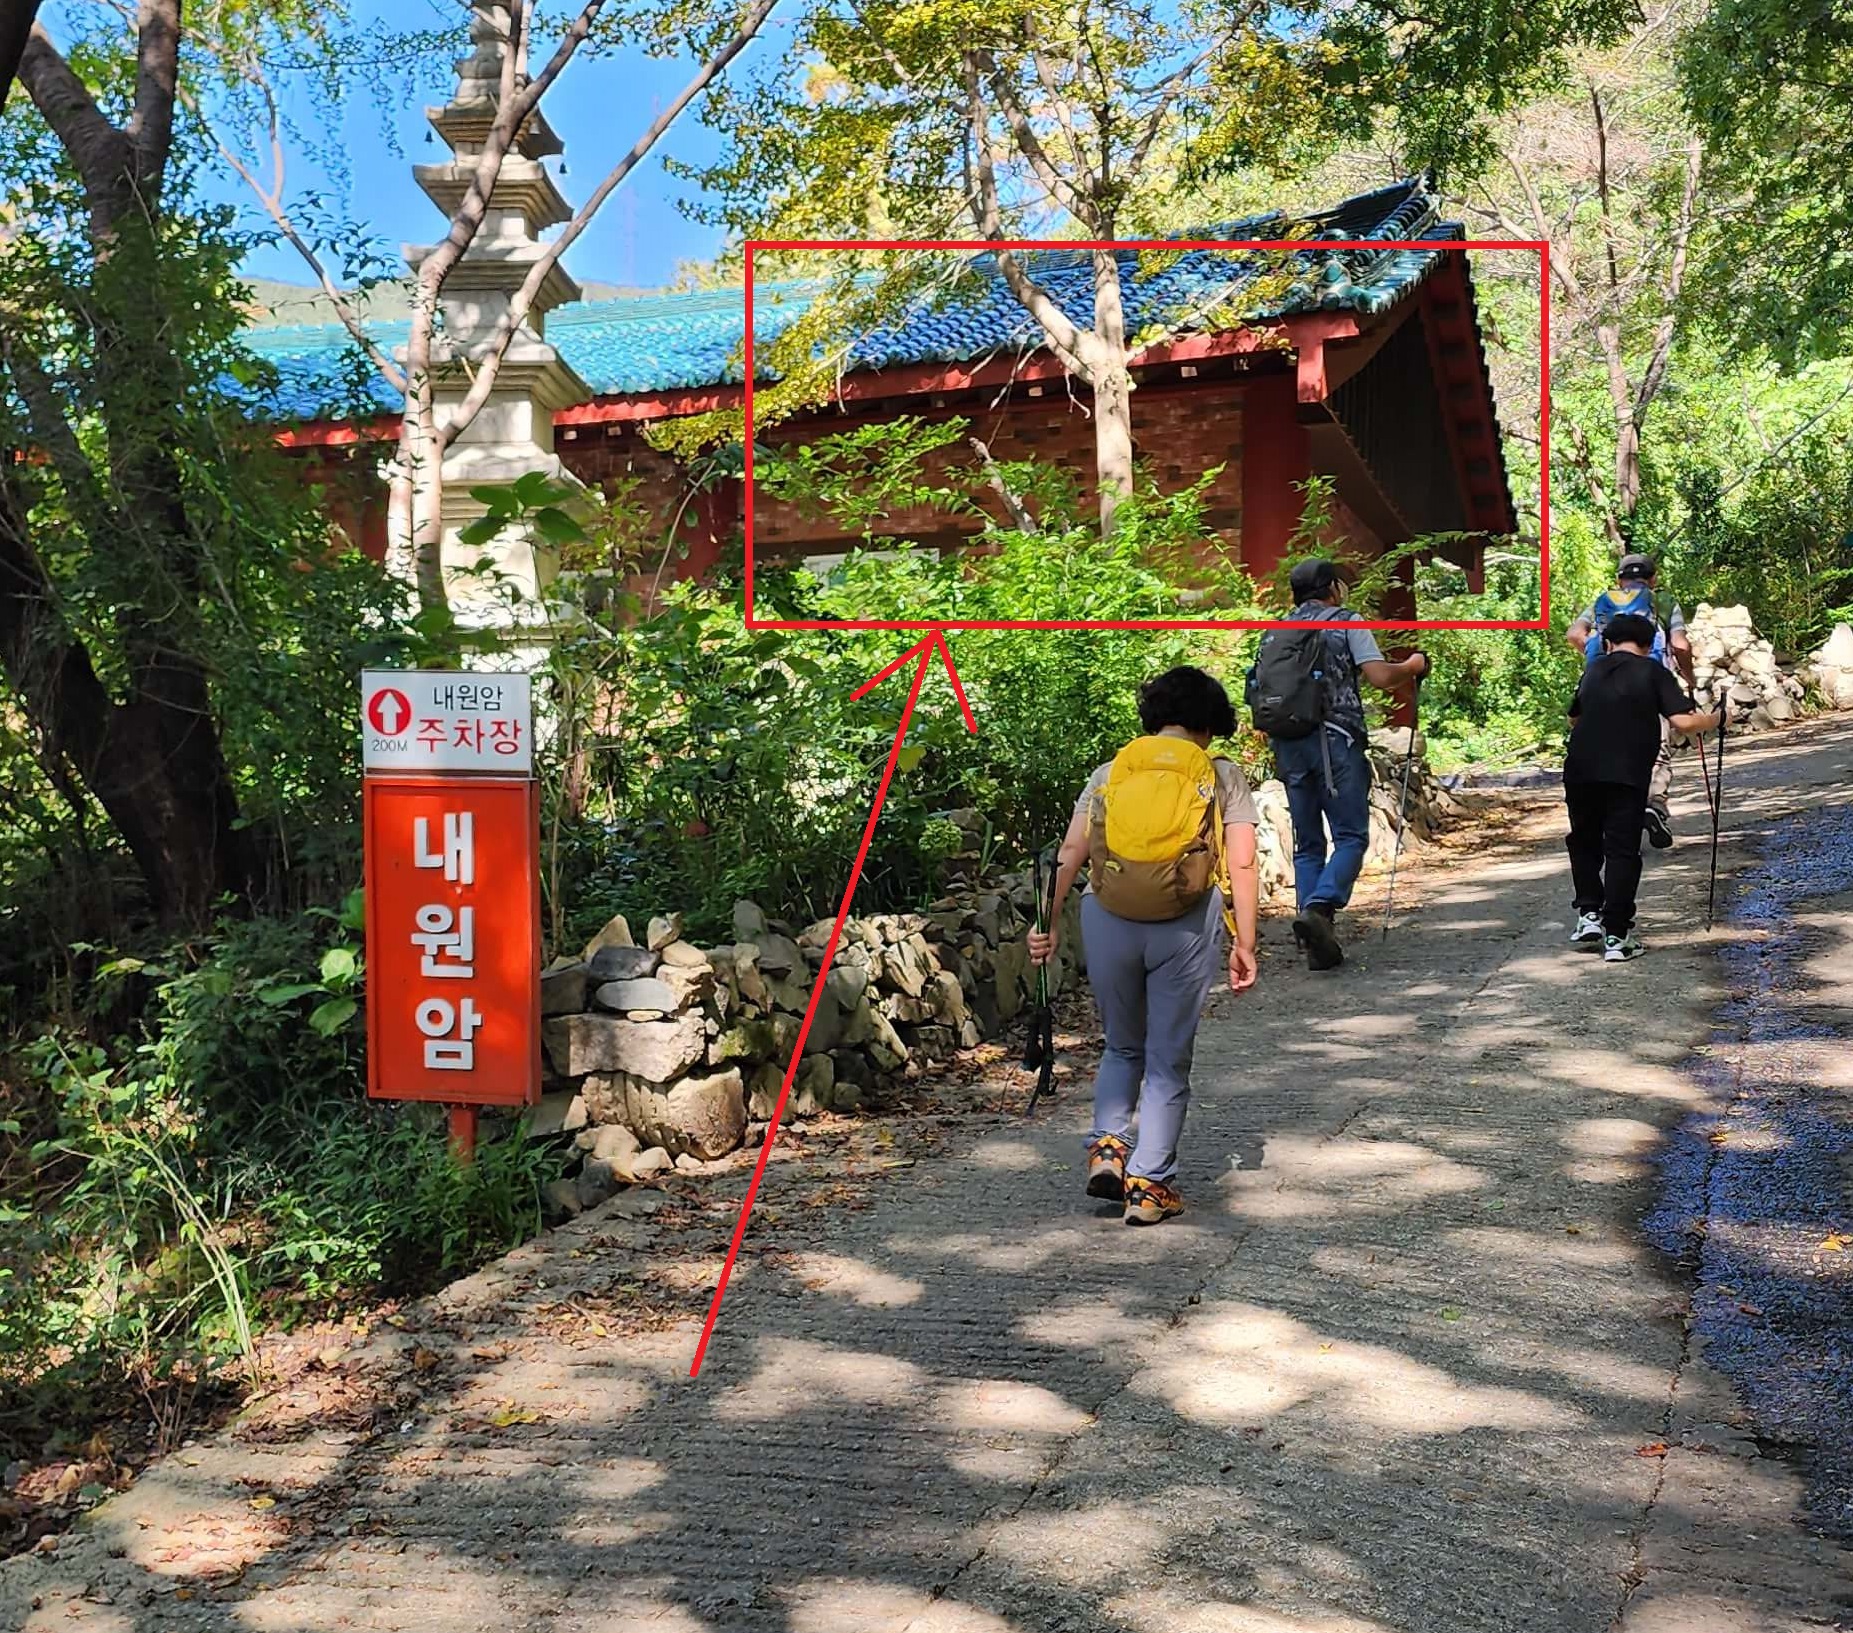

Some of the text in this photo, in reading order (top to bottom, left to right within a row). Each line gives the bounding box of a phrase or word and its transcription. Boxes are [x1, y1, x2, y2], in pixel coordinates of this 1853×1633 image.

[433, 685, 503, 711] 내원암
[372, 738, 408, 752] 200M
[416, 718, 522, 755] 주차장
[411, 811, 483, 1070] 내원암
